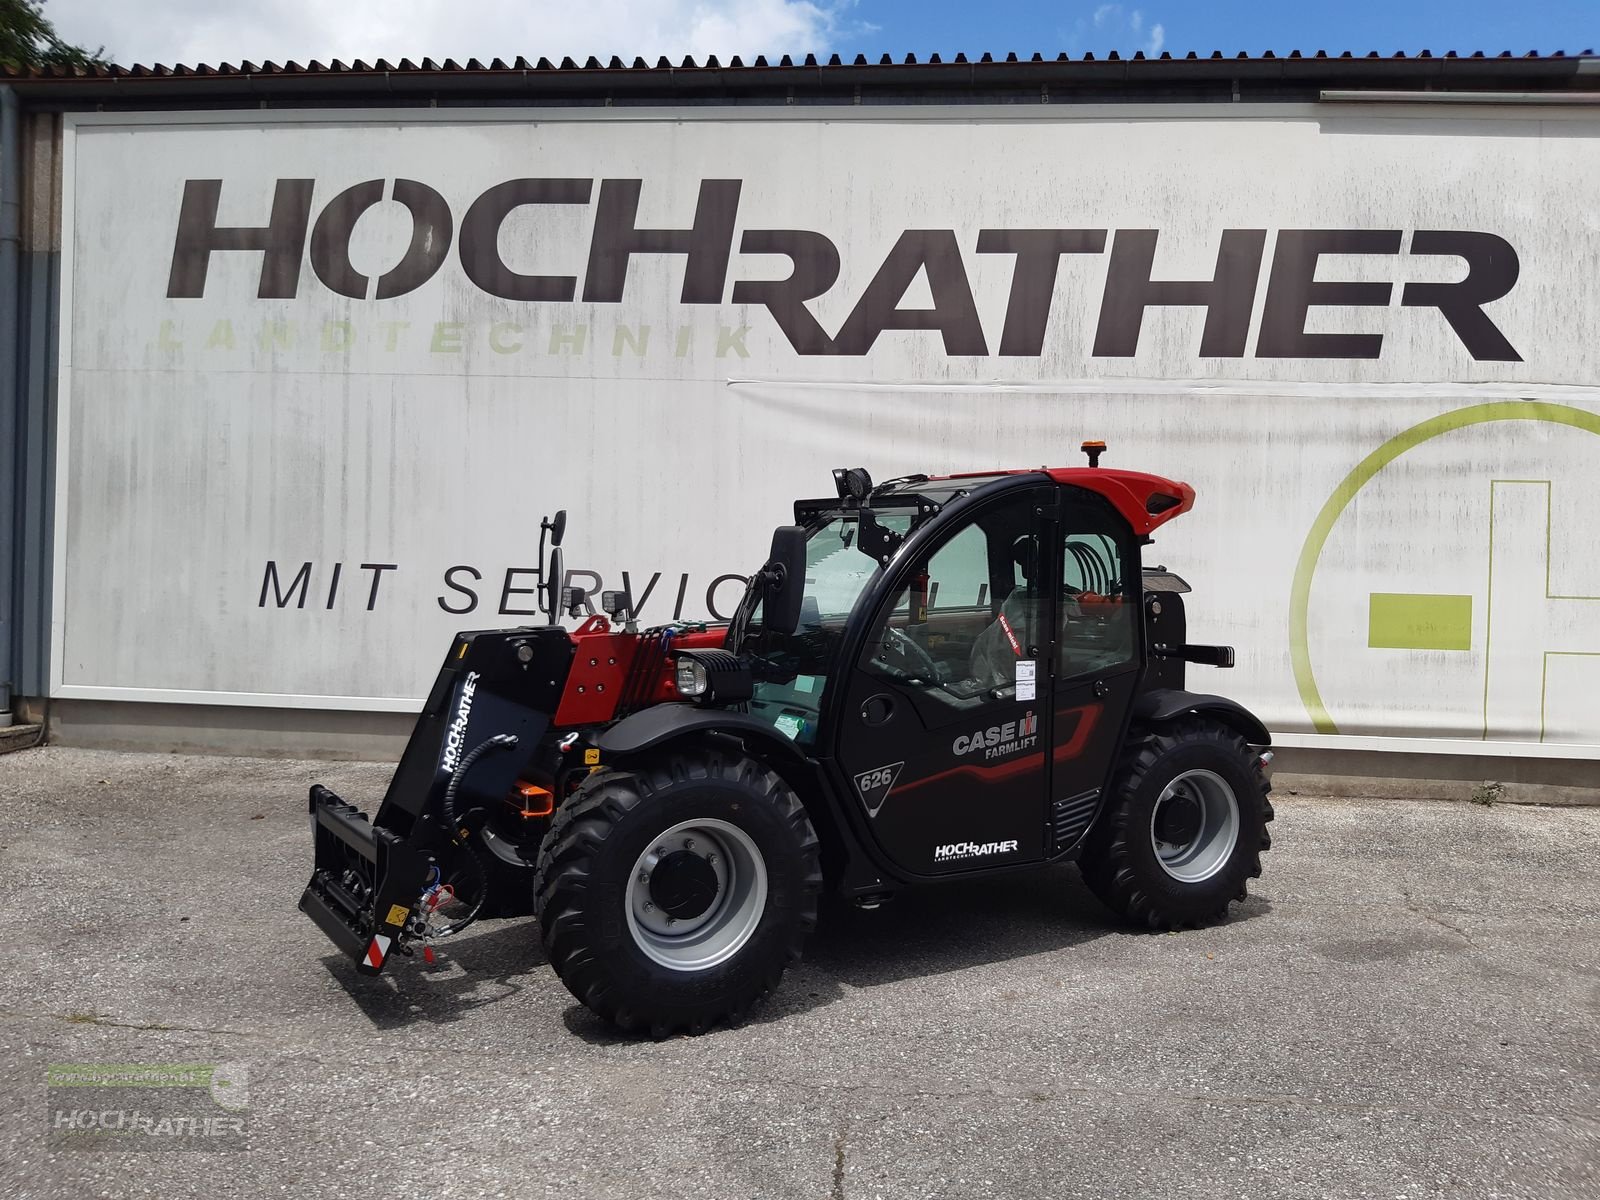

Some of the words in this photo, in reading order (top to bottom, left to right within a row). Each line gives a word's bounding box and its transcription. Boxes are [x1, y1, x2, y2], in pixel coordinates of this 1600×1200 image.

[167, 178, 1524, 362] HOCHRATHER
[158, 320, 752, 359] LANDTECHNIK
[257, 560, 398, 611] MIT
[438, 565, 816, 622] SERVIC
[1000, 615, 1010, 632] Scan
[442, 671, 480, 773] HOCHRATHER
[952, 721, 1016, 756] CASE
[985, 735, 1038, 760] FARMLIFT
[860, 768, 893, 792] 626
[934, 839, 1018, 858] HOCHRATHER
[934, 852, 975, 862] LANDTECHNIK
